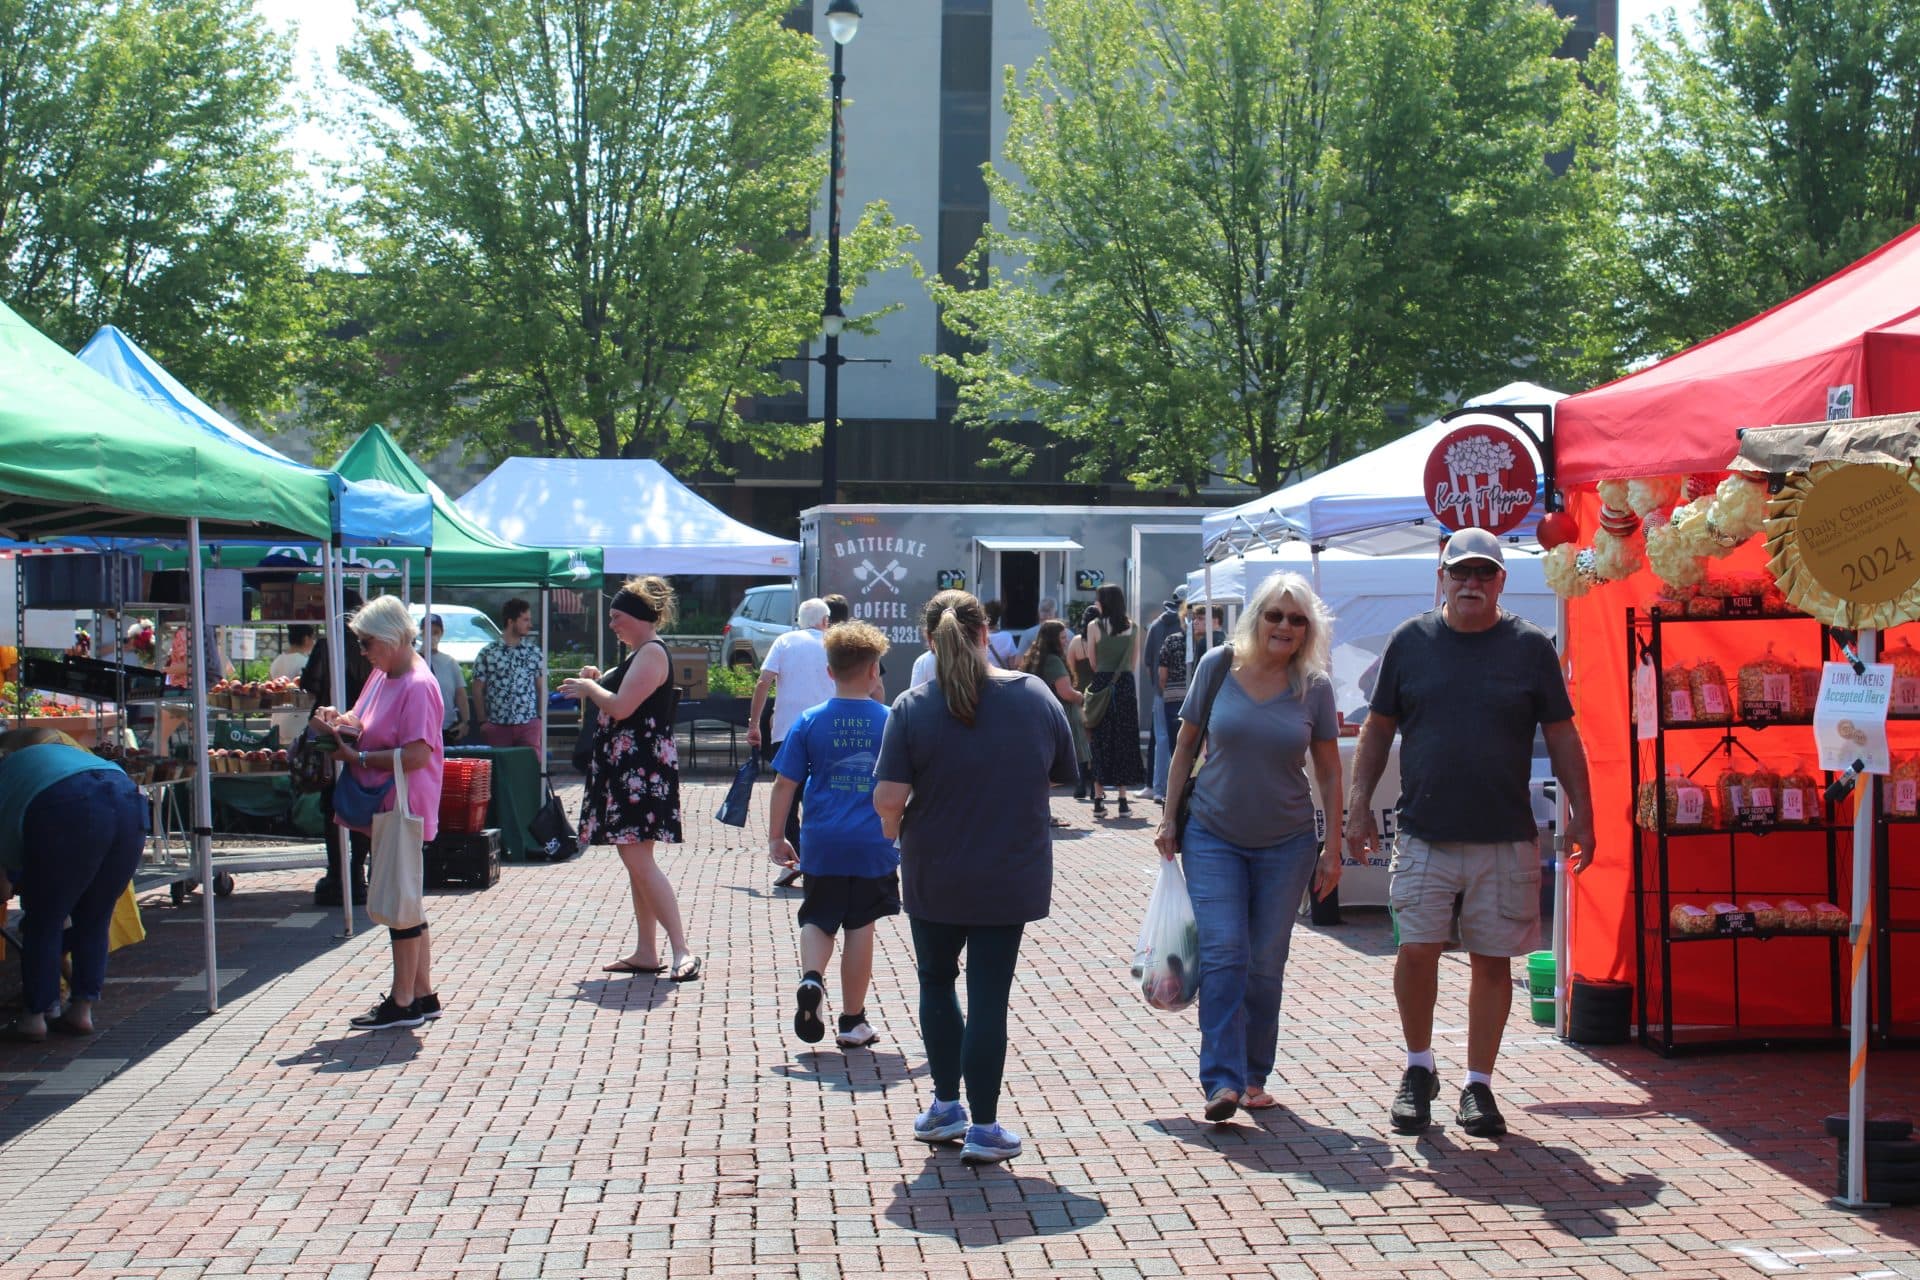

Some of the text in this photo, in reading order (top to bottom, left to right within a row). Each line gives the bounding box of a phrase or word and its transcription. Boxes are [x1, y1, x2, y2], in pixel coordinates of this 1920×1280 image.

[1435, 482, 1532, 515] Keep it Poppin
[1802, 517, 1837, 542] Daily
[1839, 484, 1904, 522] Chronicle
[834, 536, 927, 557] BATTLEAXE
[1841, 536, 1915, 592] 2024
[854, 601, 907, 618] COFFEE
[1832, 672, 1885, 687] LINK TOKENS
[1824, 688, 1886, 705] Accepted Here
[833, 718, 872, 728] FIRST
[833, 738, 872, 748] WATER
